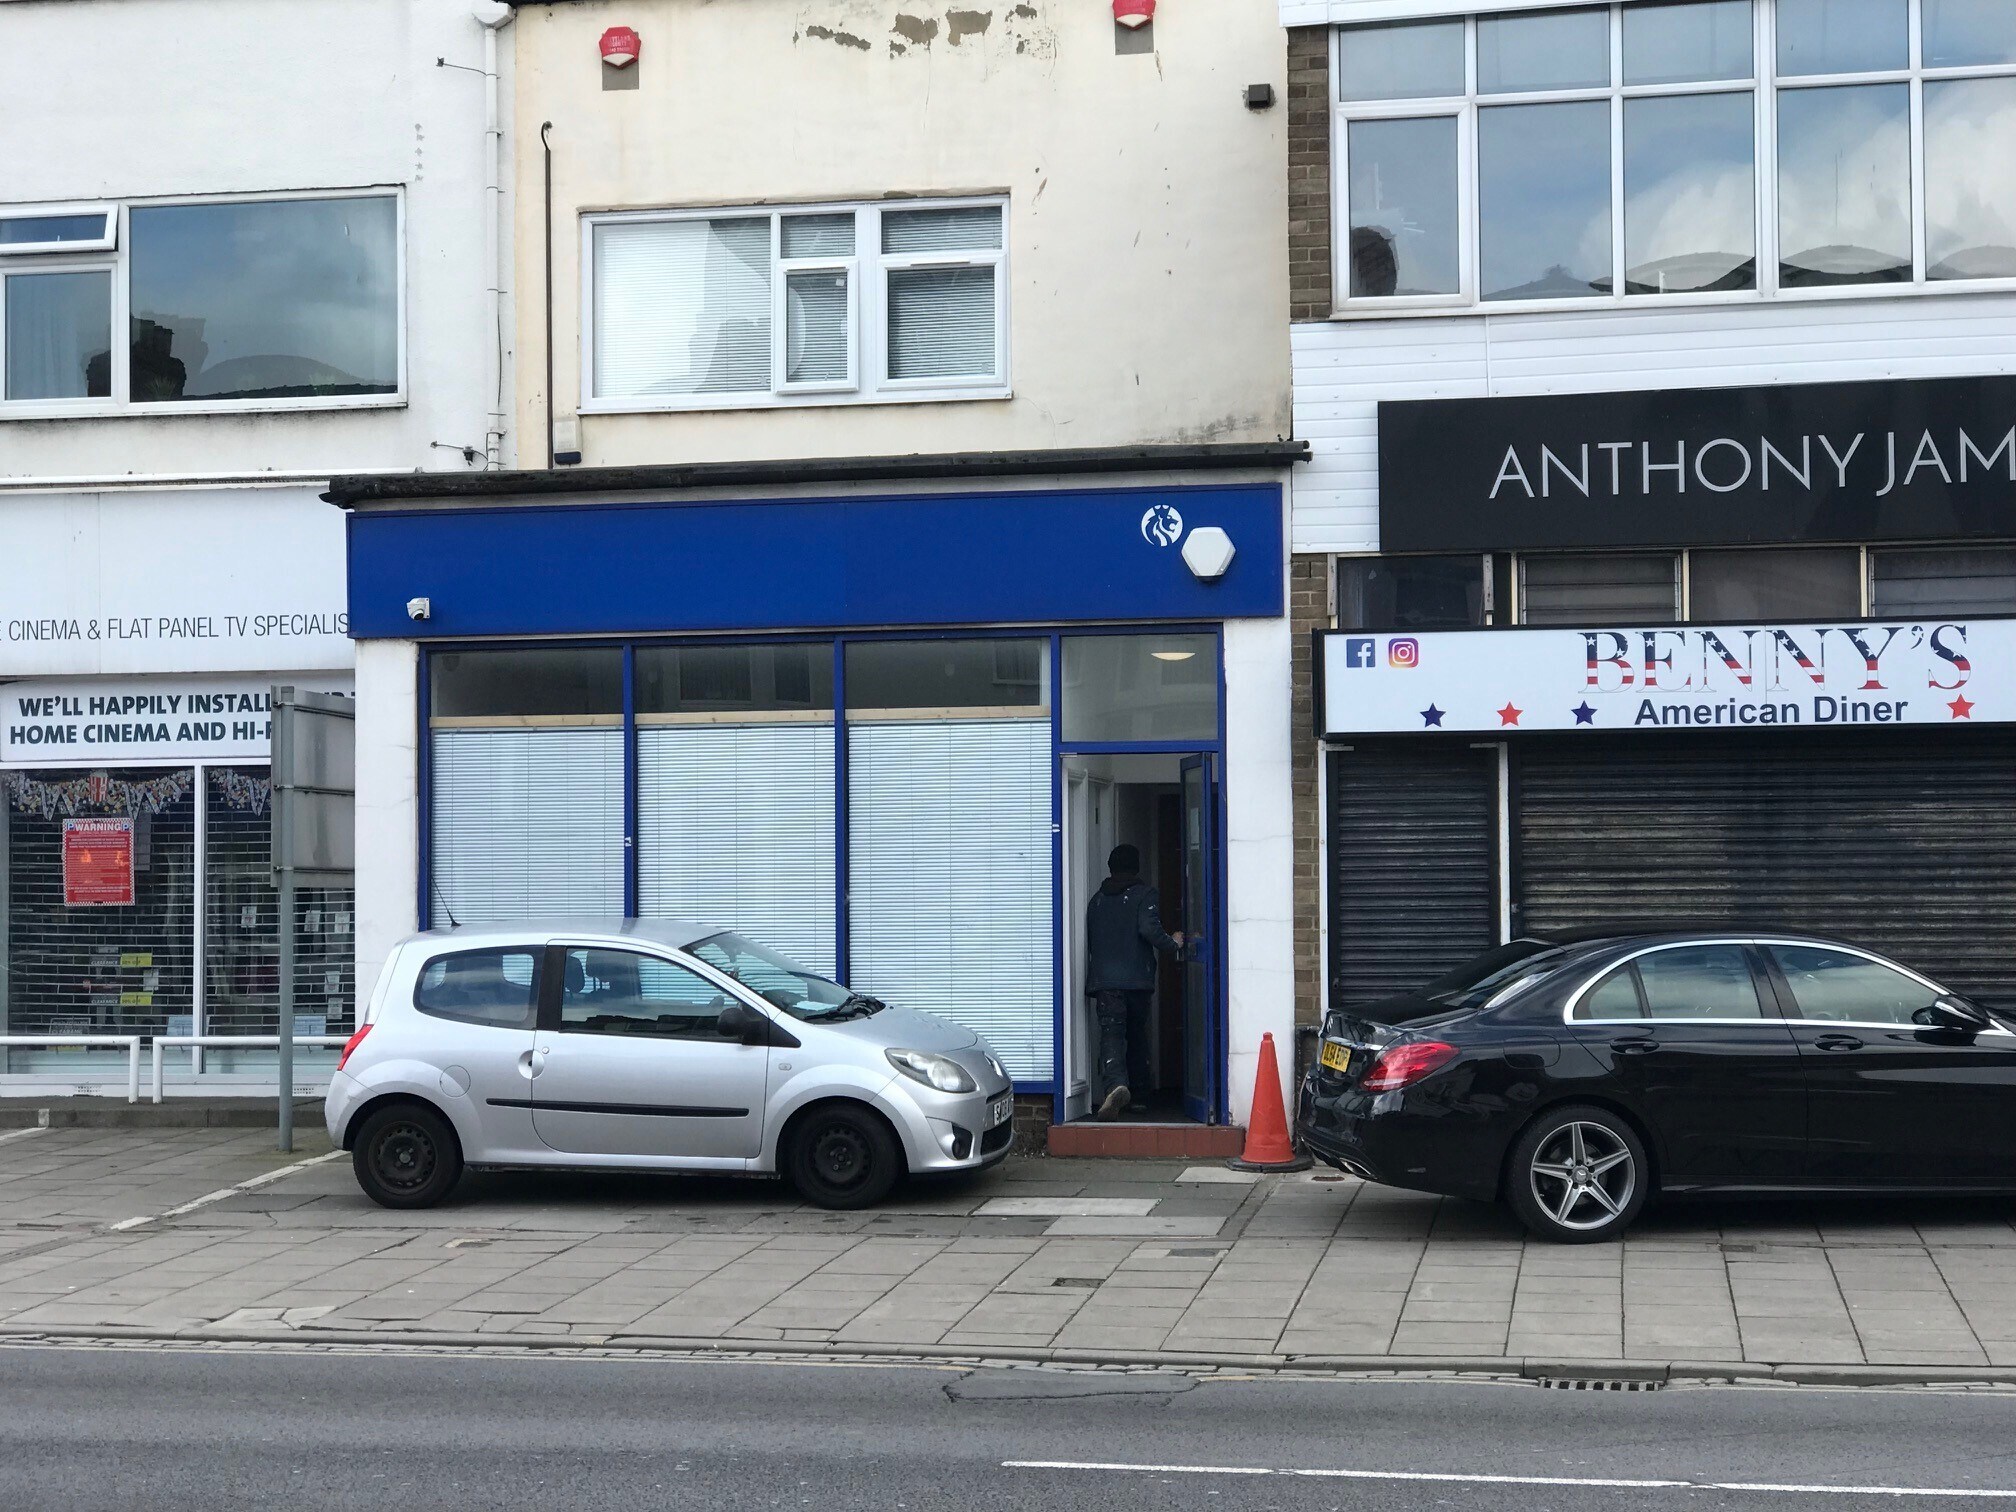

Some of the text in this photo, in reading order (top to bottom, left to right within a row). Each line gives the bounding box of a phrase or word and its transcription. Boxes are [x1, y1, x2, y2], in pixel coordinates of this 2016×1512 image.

[1489, 426, 2016, 499] ANTHONY JAM
[8, 619, 81, 641] CINEMA
[87, 618, 101, 640] &
[108, 617, 152, 639] FLAT
[159, 616, 219, 638] PANEL
[224, 615, 248, 637] TV
[254, 613, 348, 637] SPECIALIS
[1578, 623, 1971, 694] BENNY'S
[18, 693, 271, 717] WE'LL HAPPILY INSTALL
[1634, 693, 1909, 727] American Diner
[10, 725, 77, 745] HOME
[83, 723, 170, 743] CINEMA
[176, 721, 226, 741] AND
[75, 823, 120, 831] WARNING
